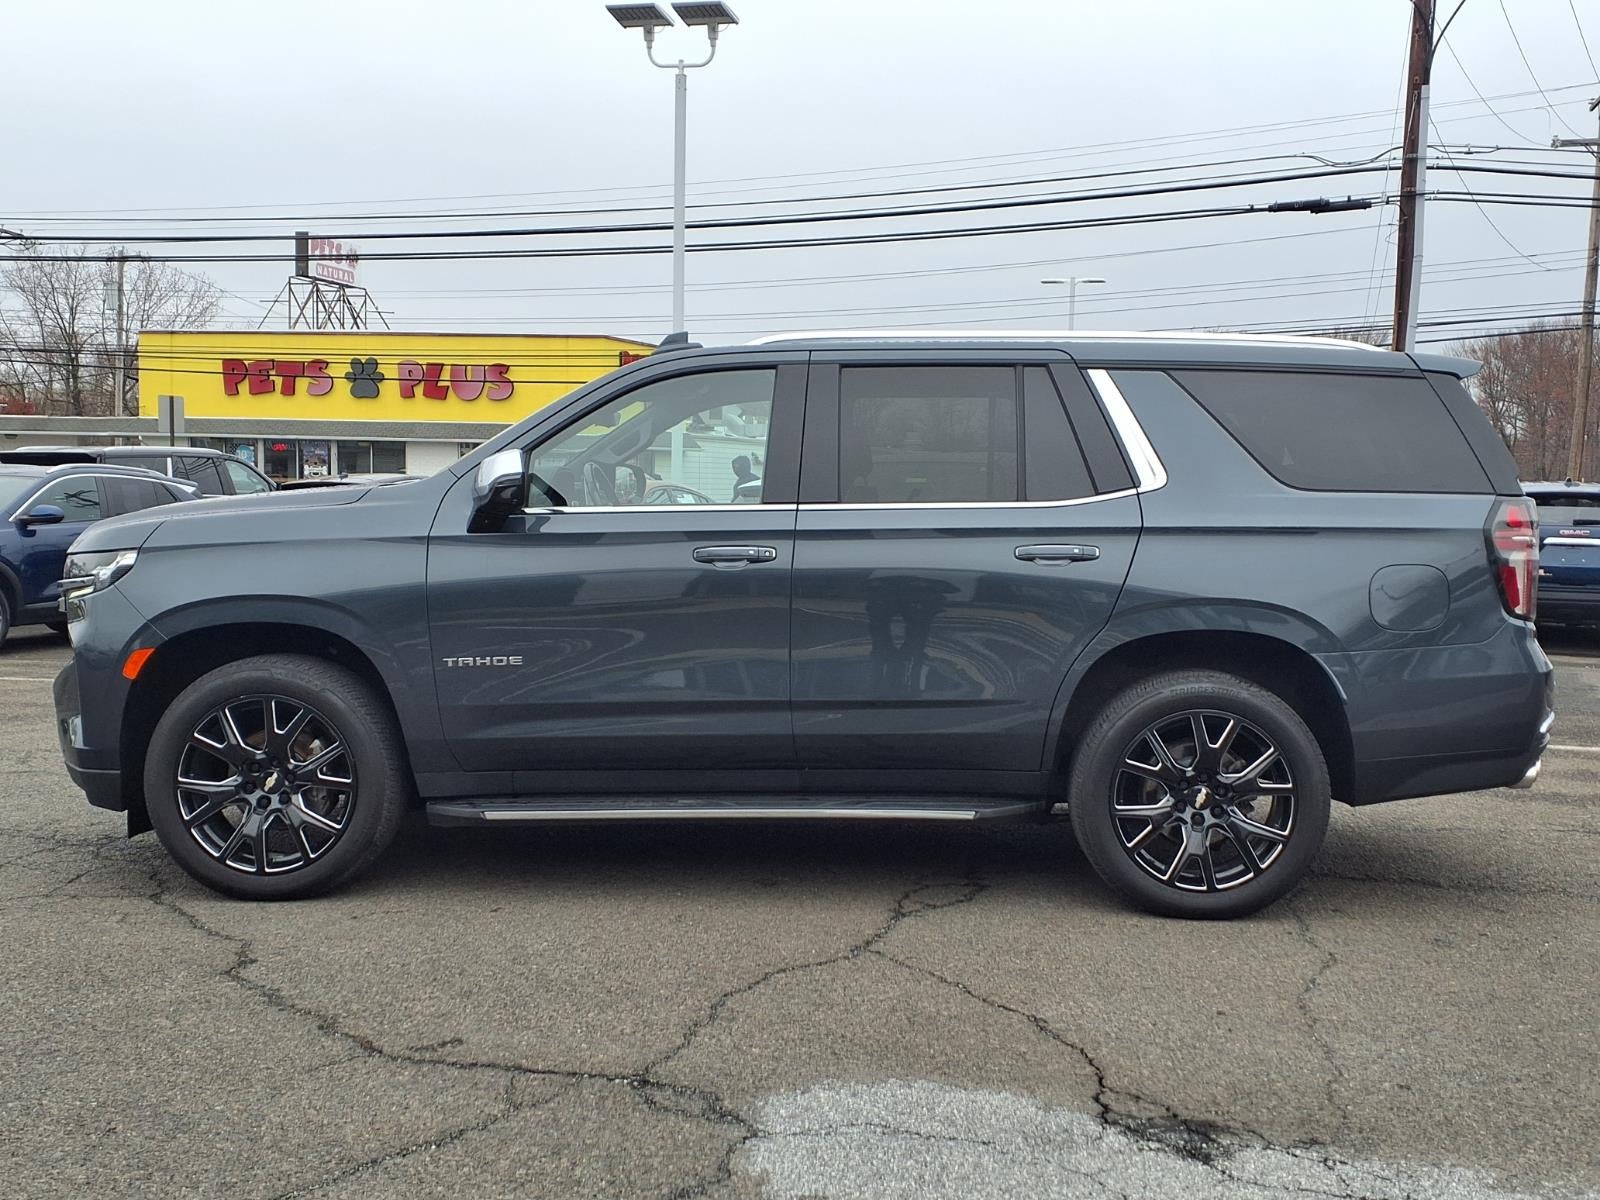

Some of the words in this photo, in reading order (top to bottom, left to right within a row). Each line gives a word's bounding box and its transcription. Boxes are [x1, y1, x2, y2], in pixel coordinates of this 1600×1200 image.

[310, 238, 342, 264] PETS
[317, 263, 354, 282] NATURAL
[222, 359, 334, 396] PETS
[398, 360, 514, 400] PLUS
[442, 656, 523, 667] TAHOE
